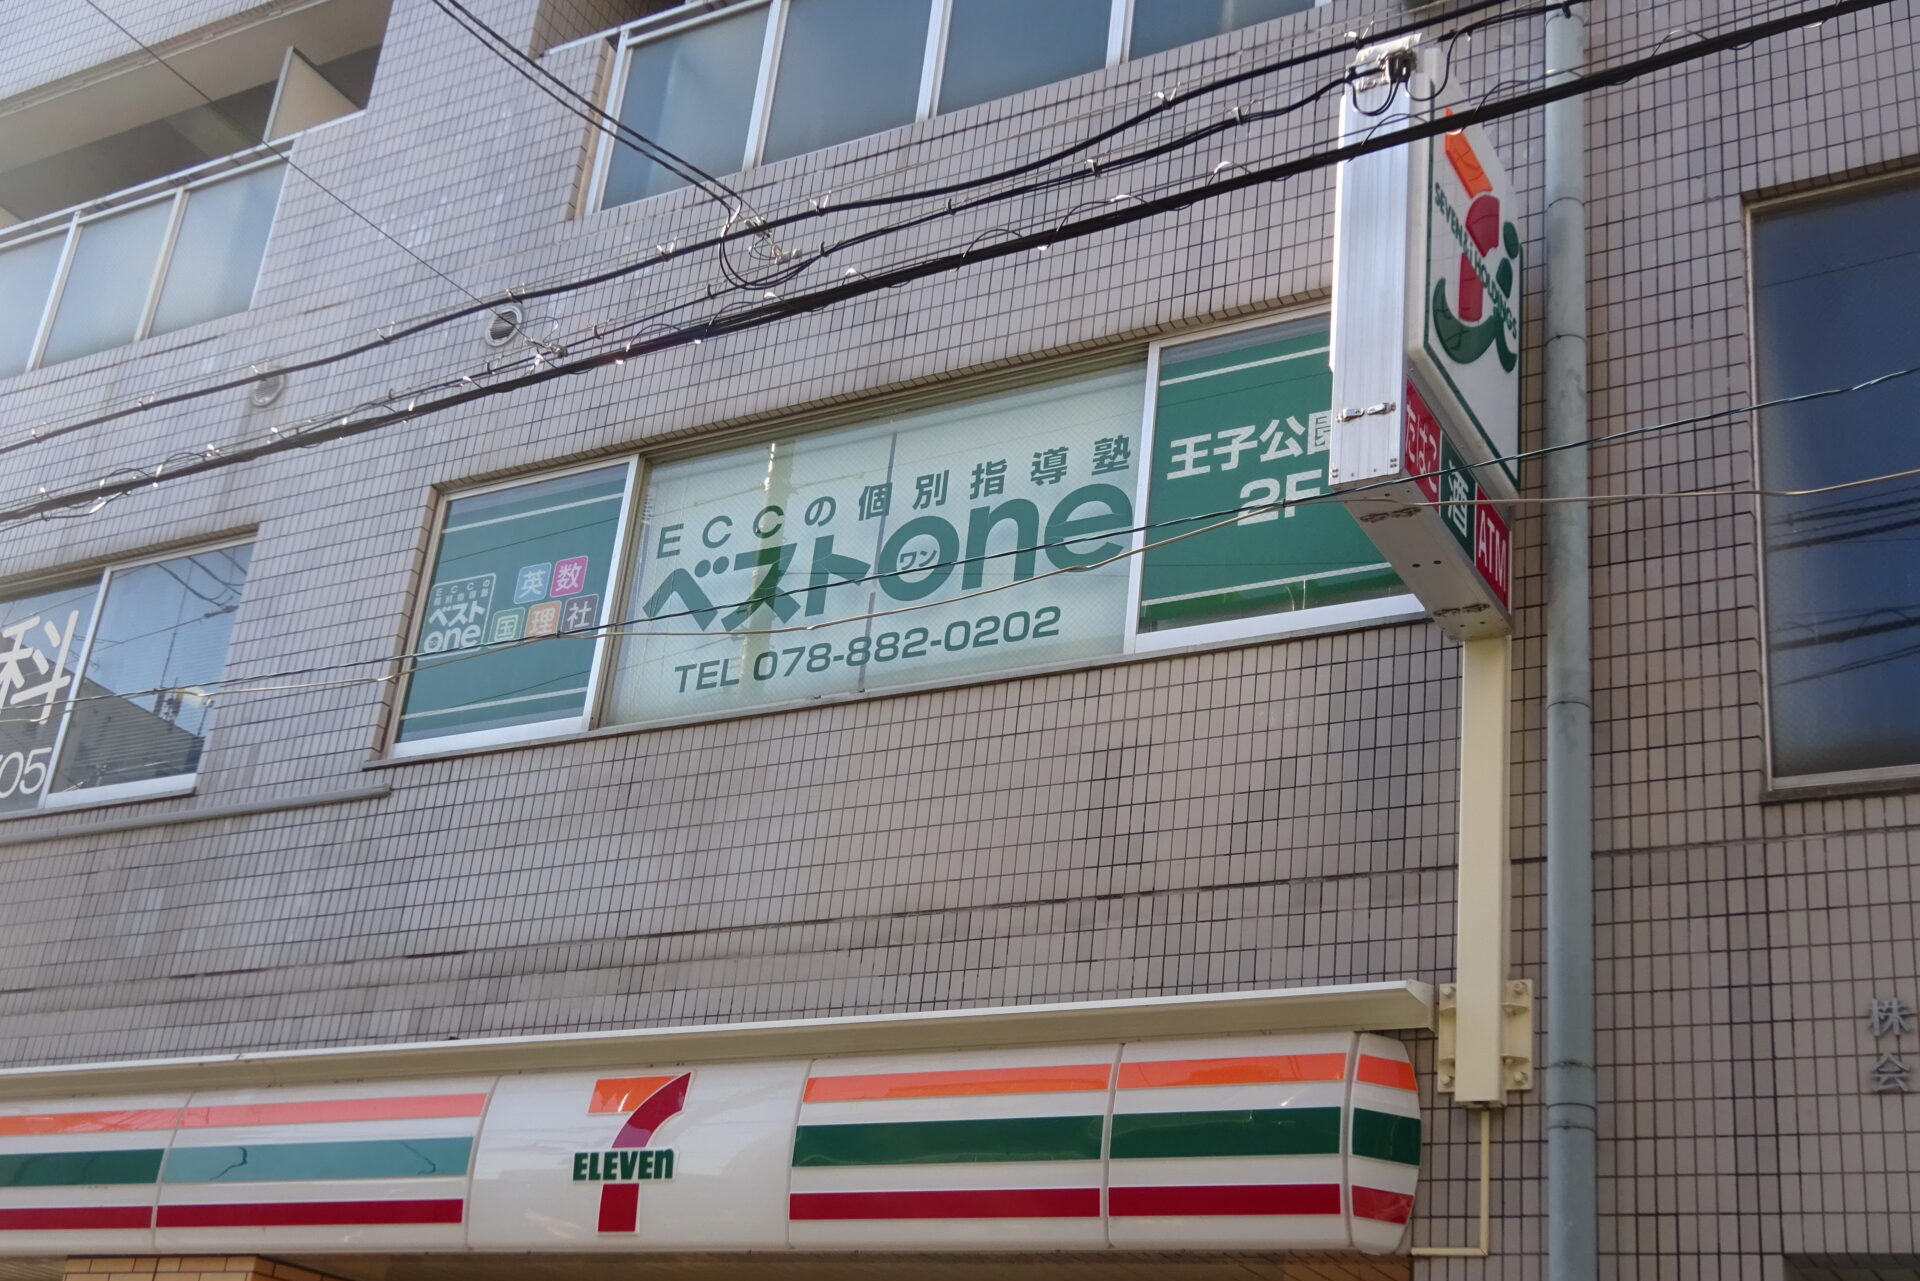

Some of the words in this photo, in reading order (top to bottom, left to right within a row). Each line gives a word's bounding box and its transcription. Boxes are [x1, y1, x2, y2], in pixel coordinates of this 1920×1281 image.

[1237, 469, 1323, 526] 2F
[1448, 459, 1469, 538] 酒
[900, 550, 938, 570] ワン
[1478, 510, 1507, 592] ATM
[675, 658, 739, 692] TEL
[753, 606, 1061, 682] 078-882-0202
[0, 747, 52, 798] 05
